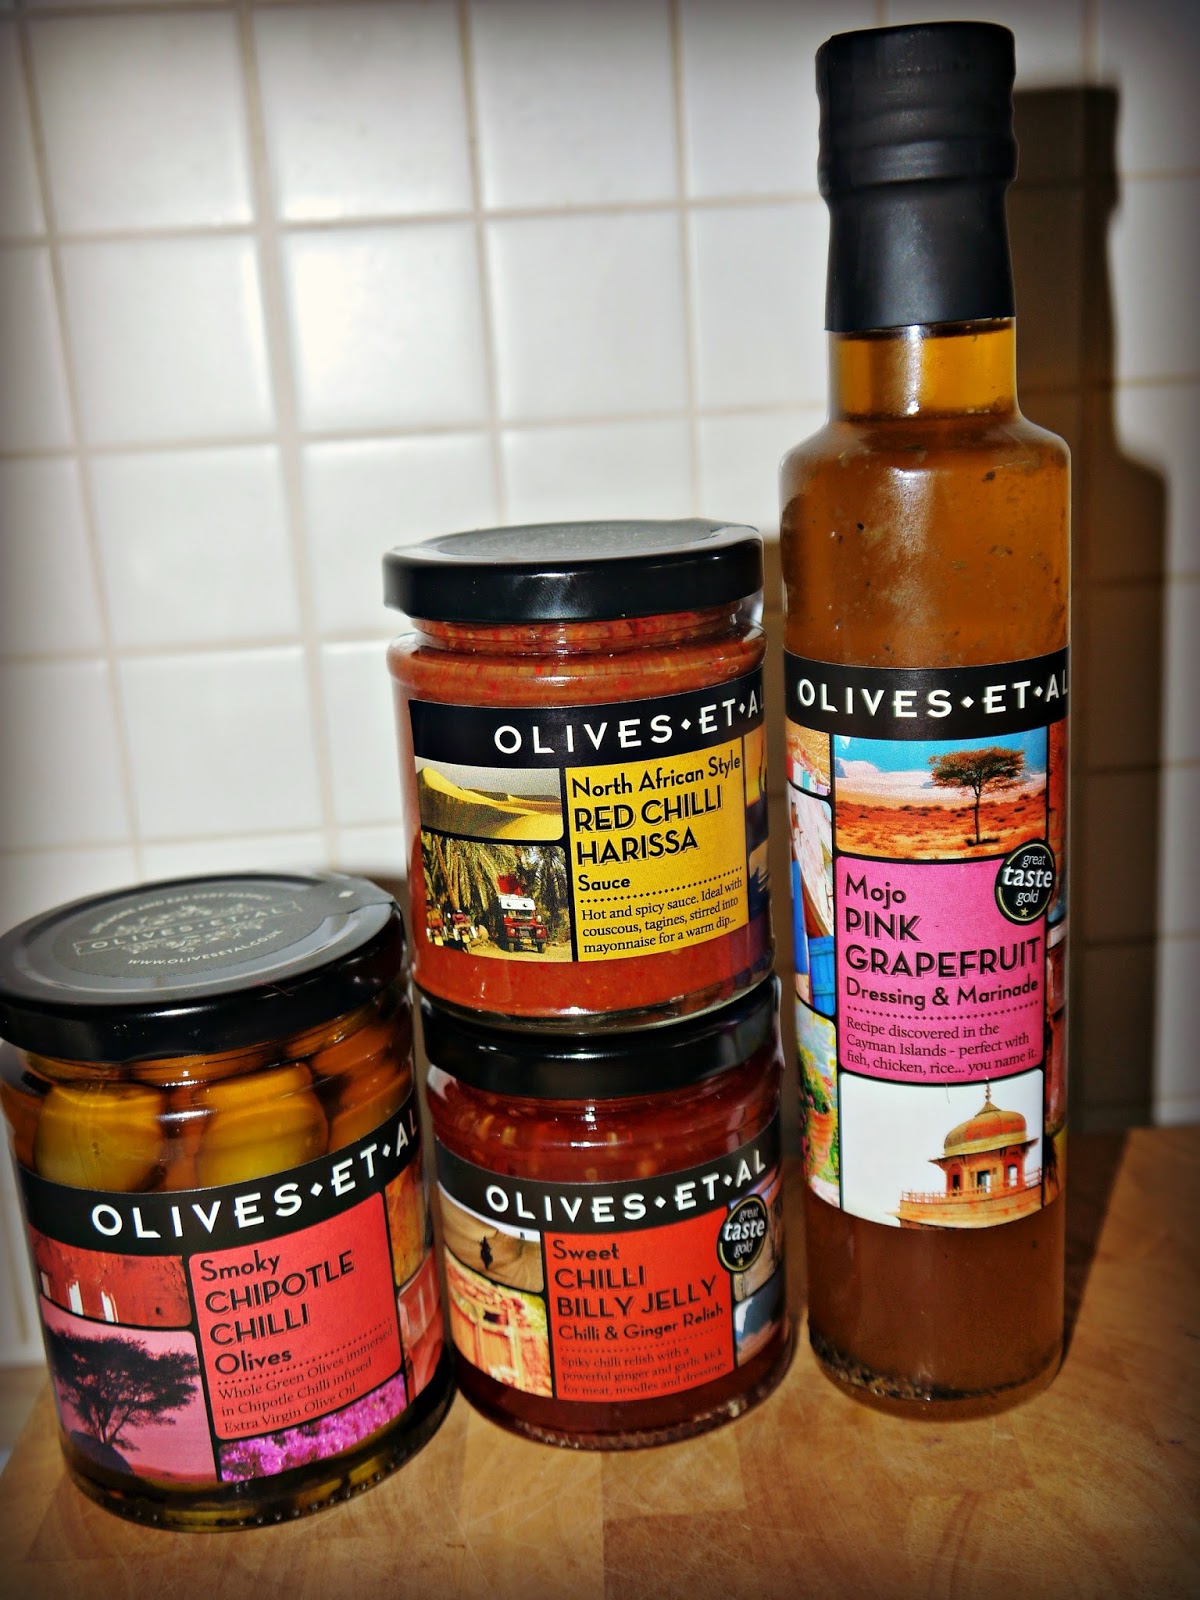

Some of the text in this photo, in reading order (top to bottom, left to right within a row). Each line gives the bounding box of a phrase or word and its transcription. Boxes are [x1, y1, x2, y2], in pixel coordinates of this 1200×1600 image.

[572, 750, 741, 798] North African Style
[574, 784, 723, 833] RED CHILLI
[577, 827, 698, 866] HARISSA
[1021, 854, 1046, 868] great
[578, 874, 630, 891] Sauce
[845, 871, 907, 910] Mojo
[1003, 865, 1053, 888] taste
[581, 877, 743, 920] Hot and spicy sauce. Ideal with
[1015, 889, 1039, 907] gold
[583, 896, 739, 938] couscous, tagines, stirred into
[845, 907, 922, 943] PINK
[583, 937, 656, 955] mayonnaise
[659, 932, 675, 945] for
[677, 931, 684, 940] a
[686, 923, 715, 937] warm
[845, 936, 1041, 978] GRAPEFRUIT
[846, 973, 1038, 1011] Dressing & Marinade
[846, 1016, 999, 1039] Recipe discovered in the
[846, 1034, 896, 1054] Cayman
[900, 1043, 947, 1057] Islands
[958, 1040, 1002, 1058] perfect
[1004, 1032, 1029, 1049] with
[847, 1050, 870, 1068] fish,
[873, 1057, 926, 1076] chicken,
[968, 1062, 992, 1075] you
[994, 1054, 1025, 1069] name
[1027, 1047, 1037, 1060] it.
[724, 1219, 765, 1241] taste
[739, 1207, 759, 1222] great
[200, 1249, 280, 1282] Smoky
[552, 1240, 620, 1260] Sweet
[733, 1239, 754, 1258] gold
[205, 1250, 356, 1316] CHIPOTLE
[554, 1265, 646, 1290] CHILLI
[557, 1276, 717, 1318] BILLY JELLY
[210, 1304, 311, 1347] CHILLI
[559, 1302, 723, 1341] Chilli & Ginger Relish
[215, 1350, 292, 1375] Olives
[219, 1326, 393, 1400] Whole Green Olives immersed
[561, 1357, 591, 1368] Spiky
[593, 1355, 621, 1368] chilli
[624, 1353, 654, 1366] relish
[657, 1349, 681, 1362] with
[562, 1371, 611, 1384] powerful
[614, 1370, 649, 1383] ginger
[652, 1363, 672, 1376] and
[704, 1348, 723, 1363] kick
[221, 1356, 373, 1417] in Chipotle Chilli infused
[563, 1383, 578, 1394] for
[615, 1380, 659, 1394] noodles
[661, 1375, 681, 1388] and
[224, 1418, 258, 1433] Extra
[261, 1408, 301, 1426] Virgin
[304, 1393, 336, 1413] Olive
